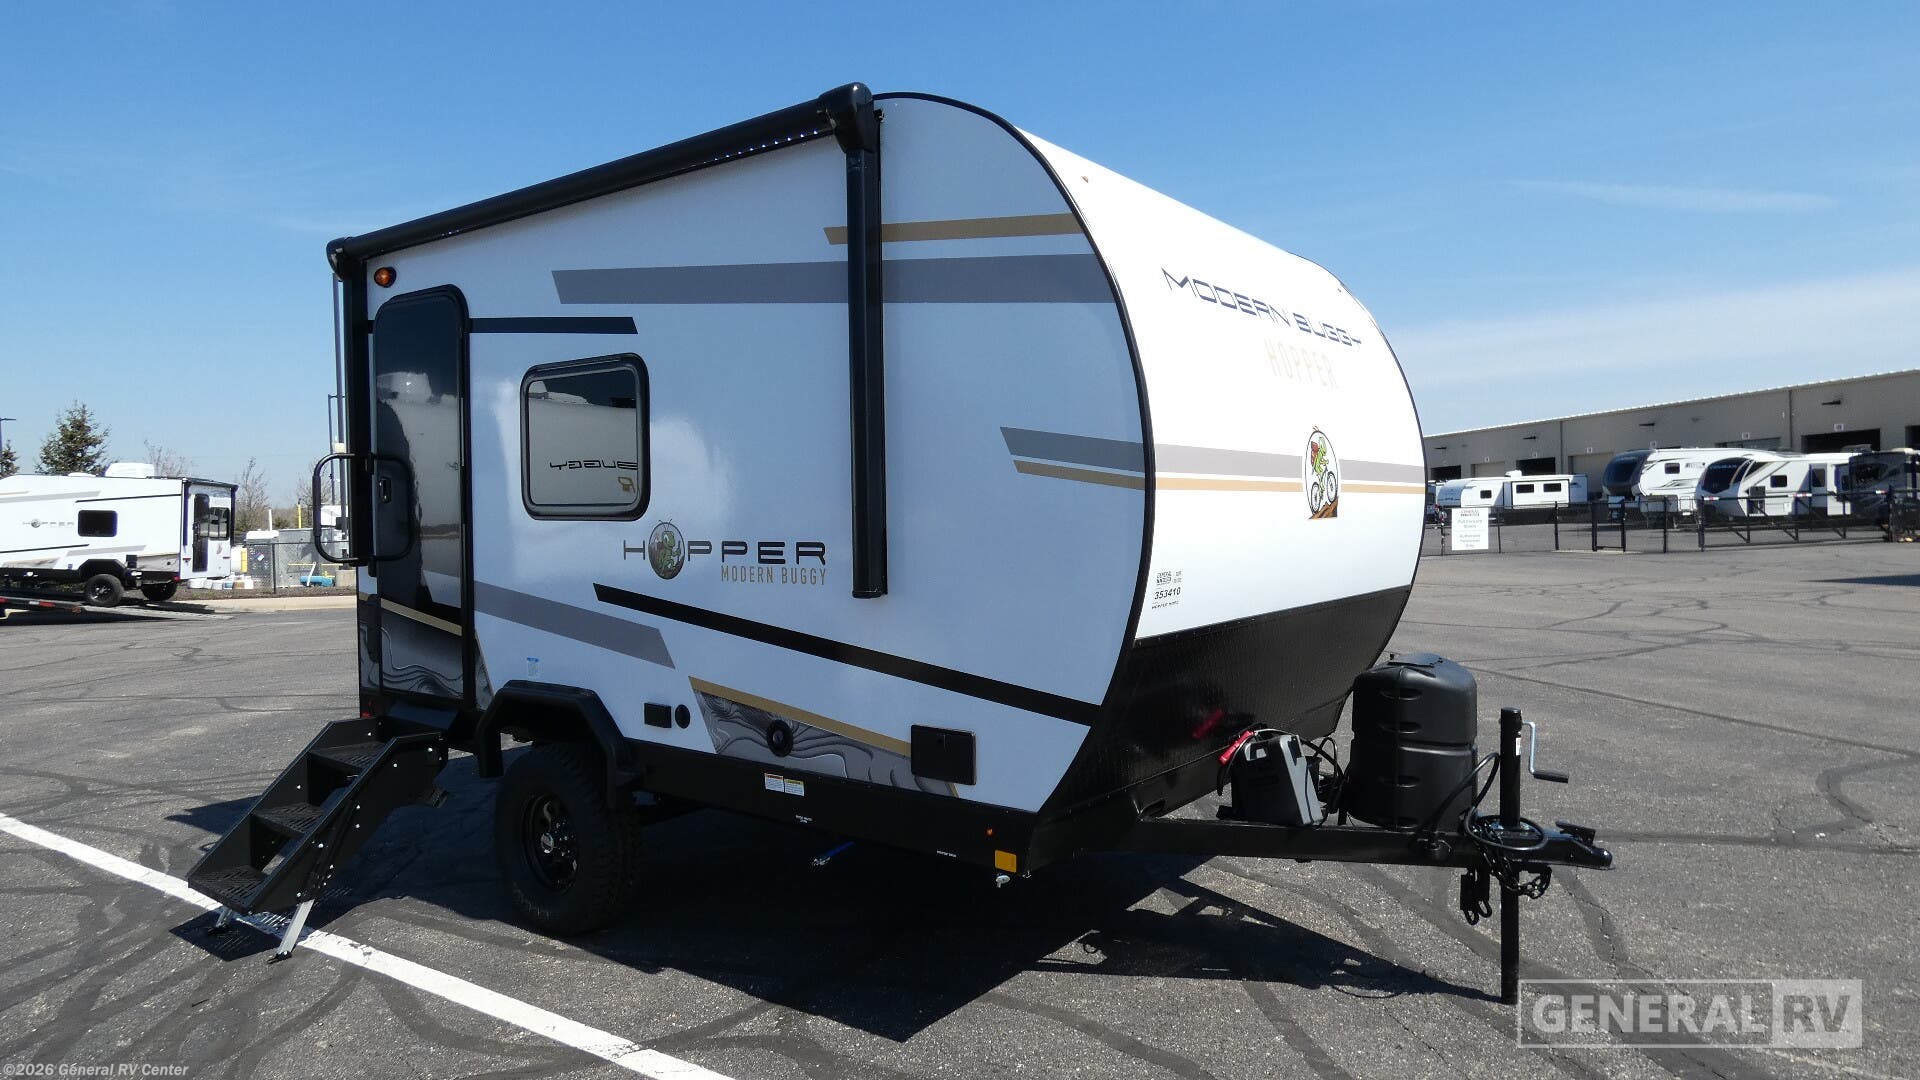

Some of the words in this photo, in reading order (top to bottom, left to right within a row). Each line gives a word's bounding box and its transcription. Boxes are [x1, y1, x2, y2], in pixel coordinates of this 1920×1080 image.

[1161, 268, 1291, 327] MODERN
[1292, 312, 1362, 346] BUGGY
[1264, 338, 1338, 391] HOPPER
[721, 565, 774, 584] MODERN
[781, 567, 826, 585] BUGGY
[1154, 586, 1181, 600] 353410
